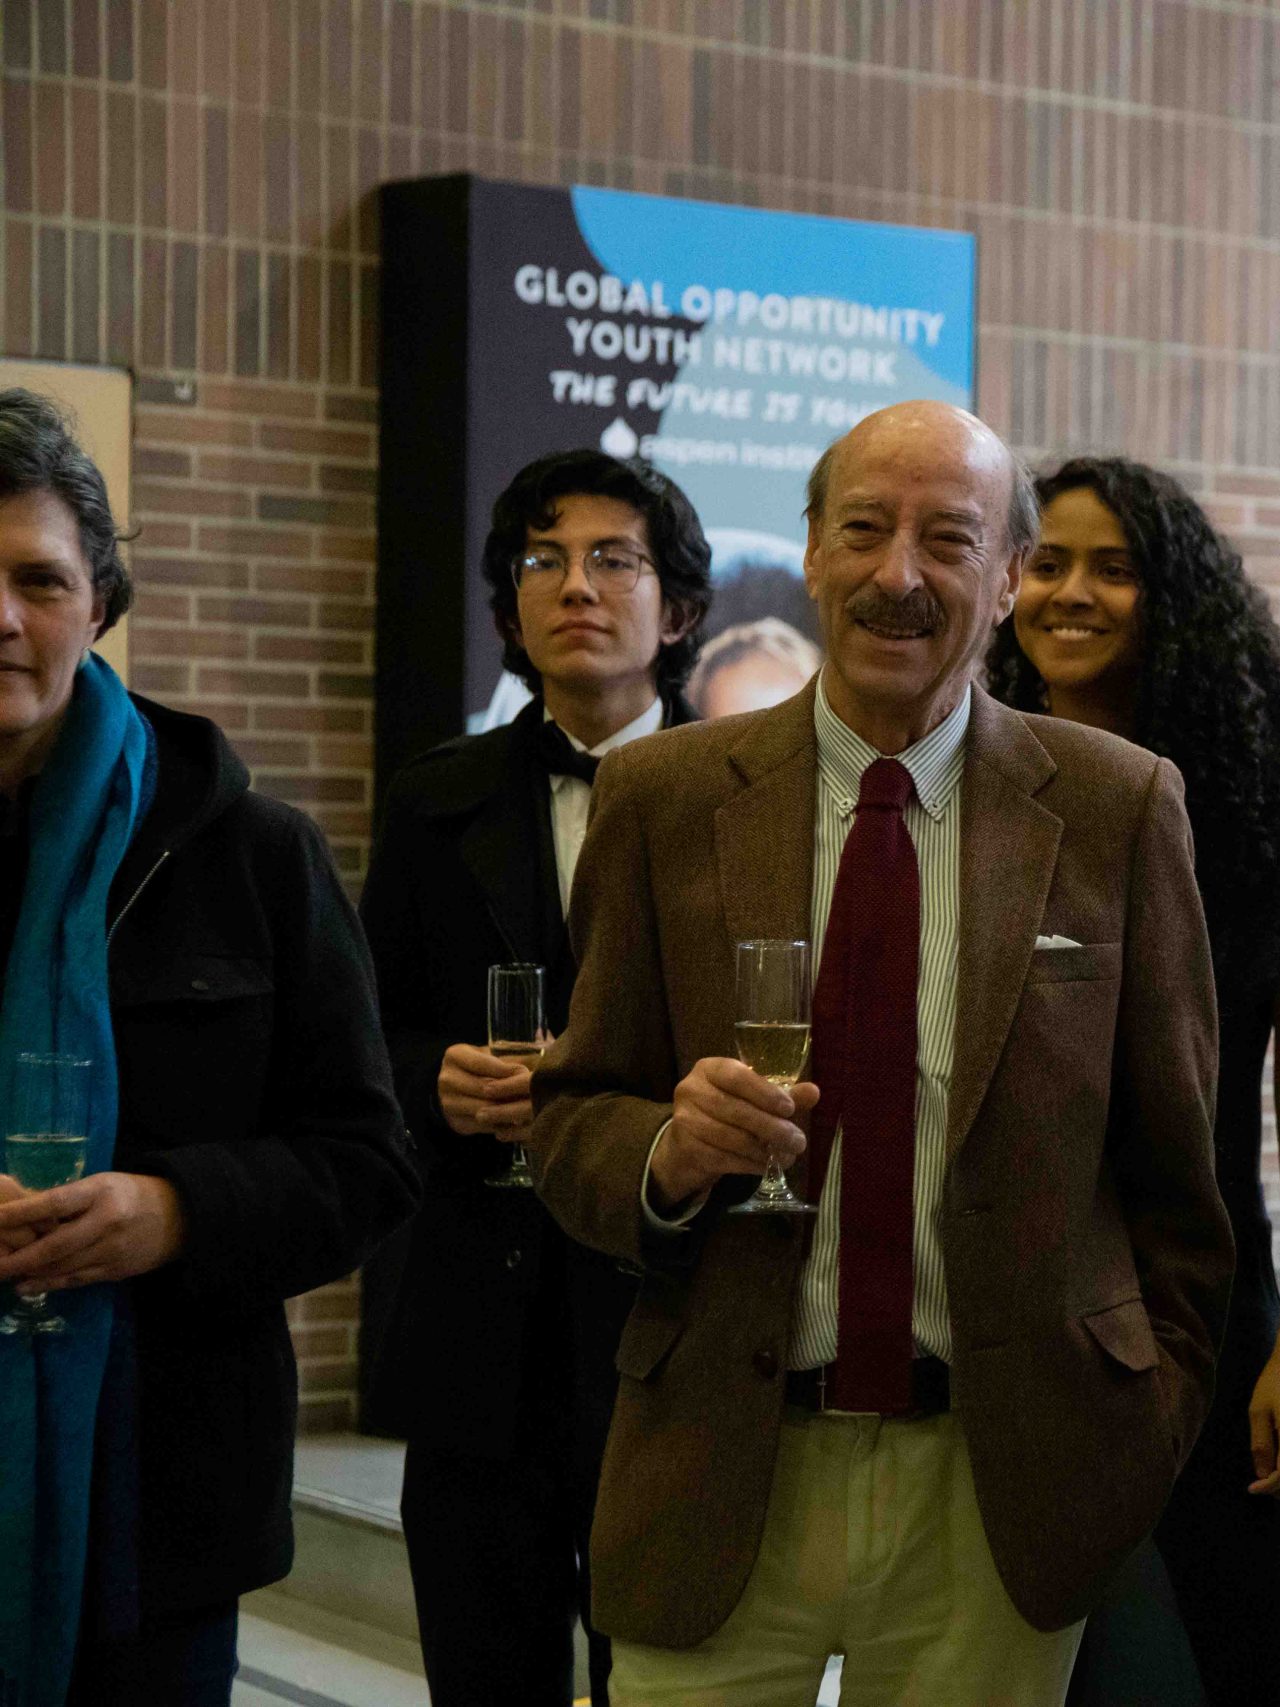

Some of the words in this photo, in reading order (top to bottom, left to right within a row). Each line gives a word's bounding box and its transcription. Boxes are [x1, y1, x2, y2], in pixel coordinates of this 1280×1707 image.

[514, 264, 672, 319] GLOBAL
[681, 285, 944, 346] OPPORTUNITY
[566, 317, 701, 366] YOUTH
[713, 334, 897, 385] NETWORK
[550, 370, 617, 407] THE
[627, 377, 751, 420] FUTURE
